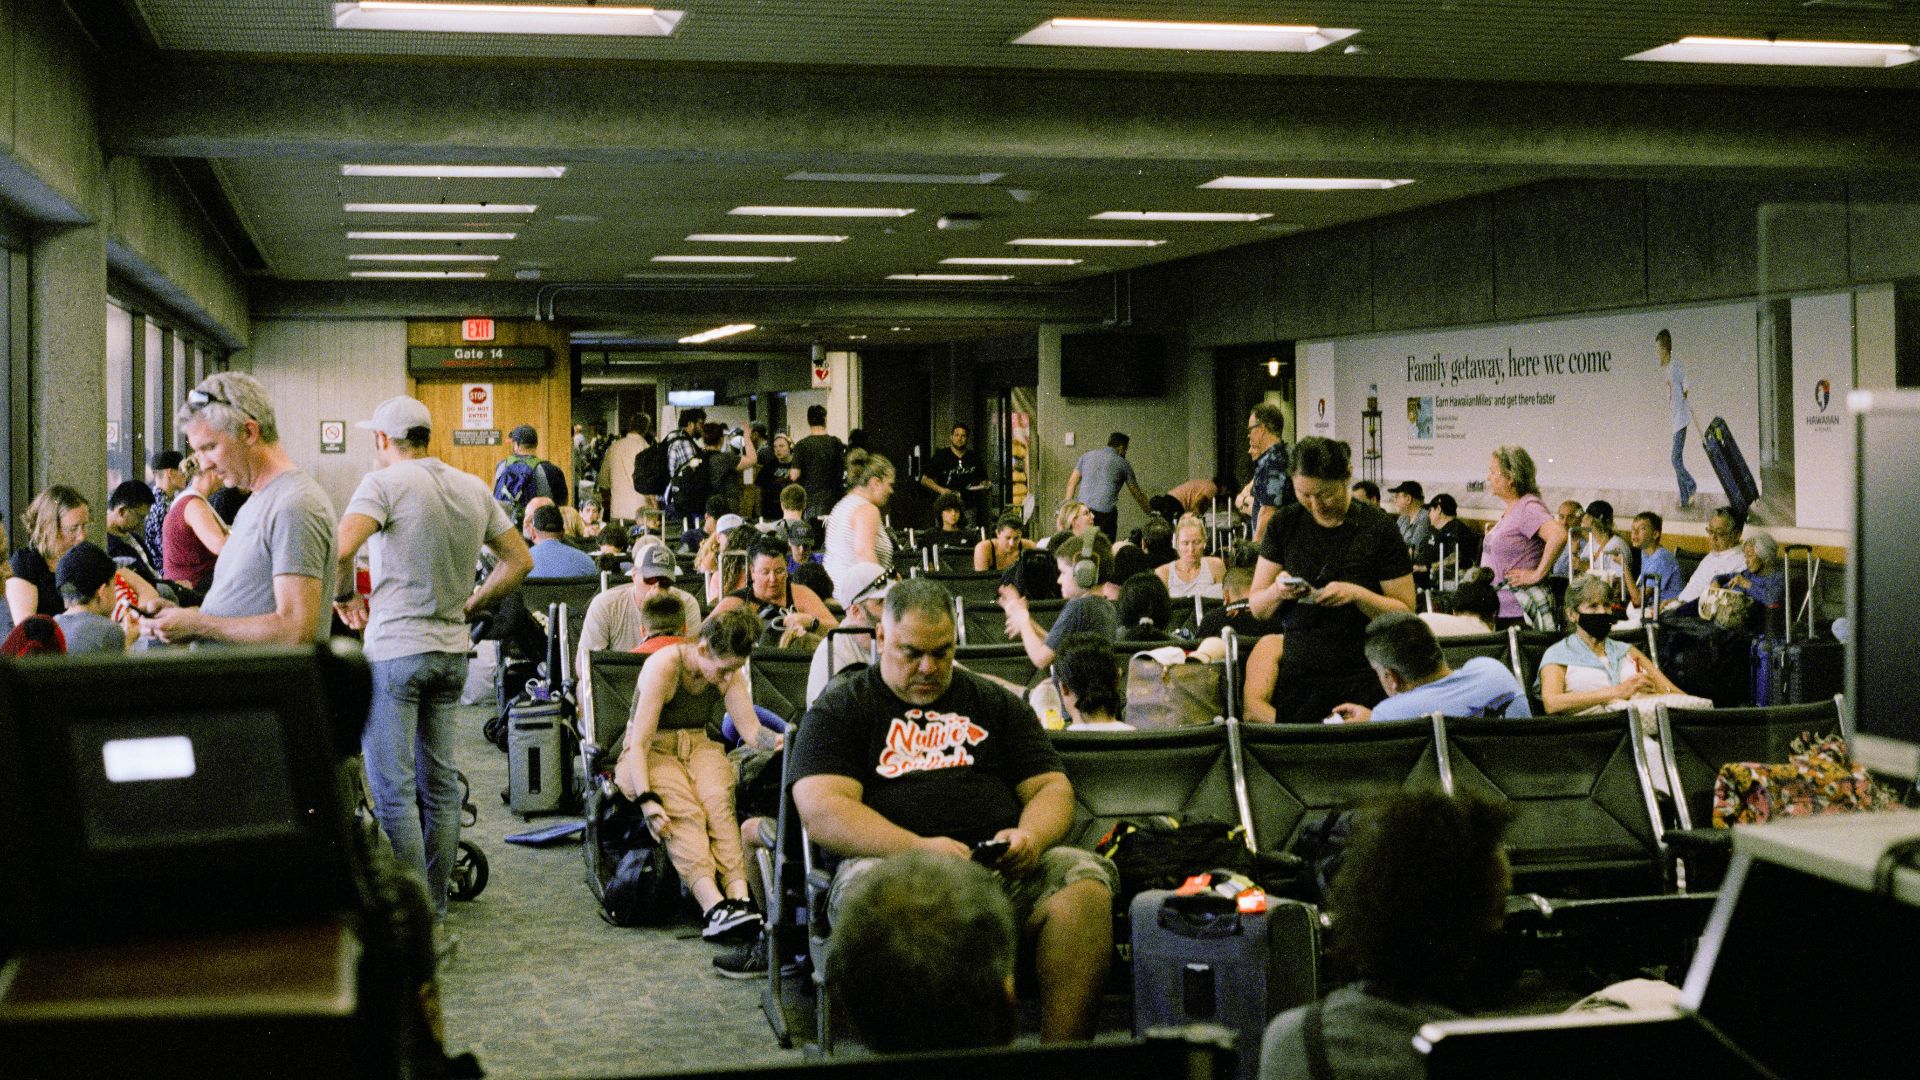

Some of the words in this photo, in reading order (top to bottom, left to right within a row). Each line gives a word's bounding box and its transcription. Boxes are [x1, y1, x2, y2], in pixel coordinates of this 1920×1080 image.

[467, 319, 490, 338] EXIT
[454, 348, 484, 359] Gate
[490, 348, 503, 359] 14
[1406, 353, 1448, 387] Family
[1451, 354, 1505, 388] getaway,
[1508, 347, 1540, 377] here
[1544, 353, 1565, 375] we
[1568, 349, 1612, 374] come
[469, 391, 486, 400] STOP
[1435, 396, 1449, 408] Earn
[1494, 394, 1506, 406] and
[1507, 395, 1518, 409] get
[1518, 393, 1536, 406] there
[1536, 391, 1557, 405] faster
[1806, 415, 1840, 425] HAWAIIAN
